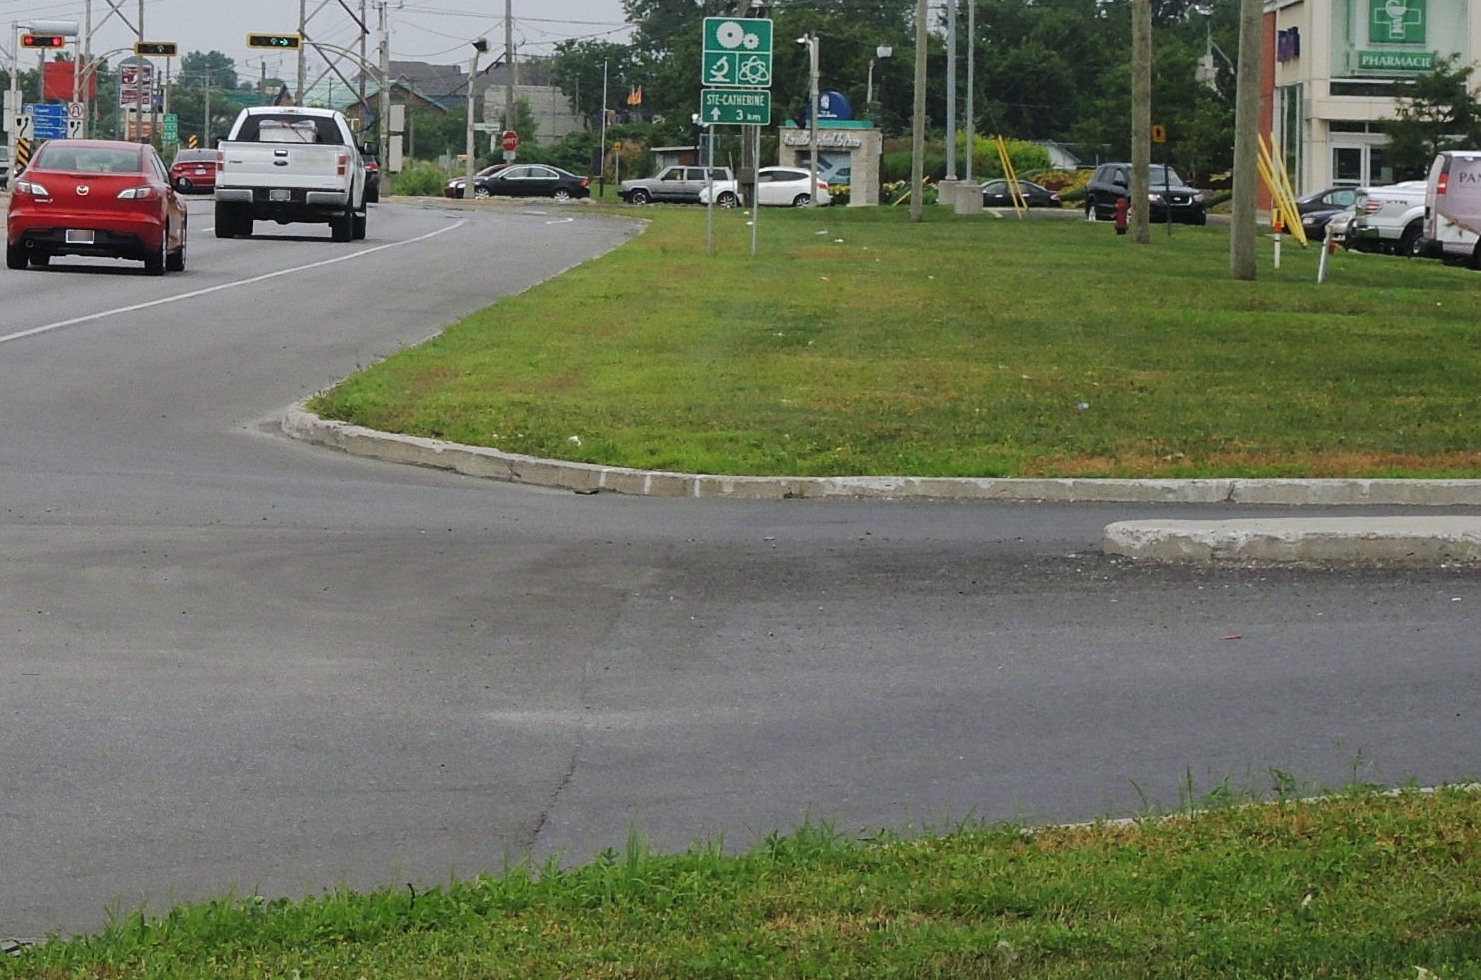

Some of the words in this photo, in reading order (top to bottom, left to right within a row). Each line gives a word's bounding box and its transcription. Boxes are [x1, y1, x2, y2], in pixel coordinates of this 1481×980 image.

[1362, 55, 1432, 67] PHARMACIE
[706, 94, 765, 106] STE-CATHERINE
[735, 109, 744, 121] 3
[747, 113, 761, 122] km
[1459, 172, 1481, 183] PA
